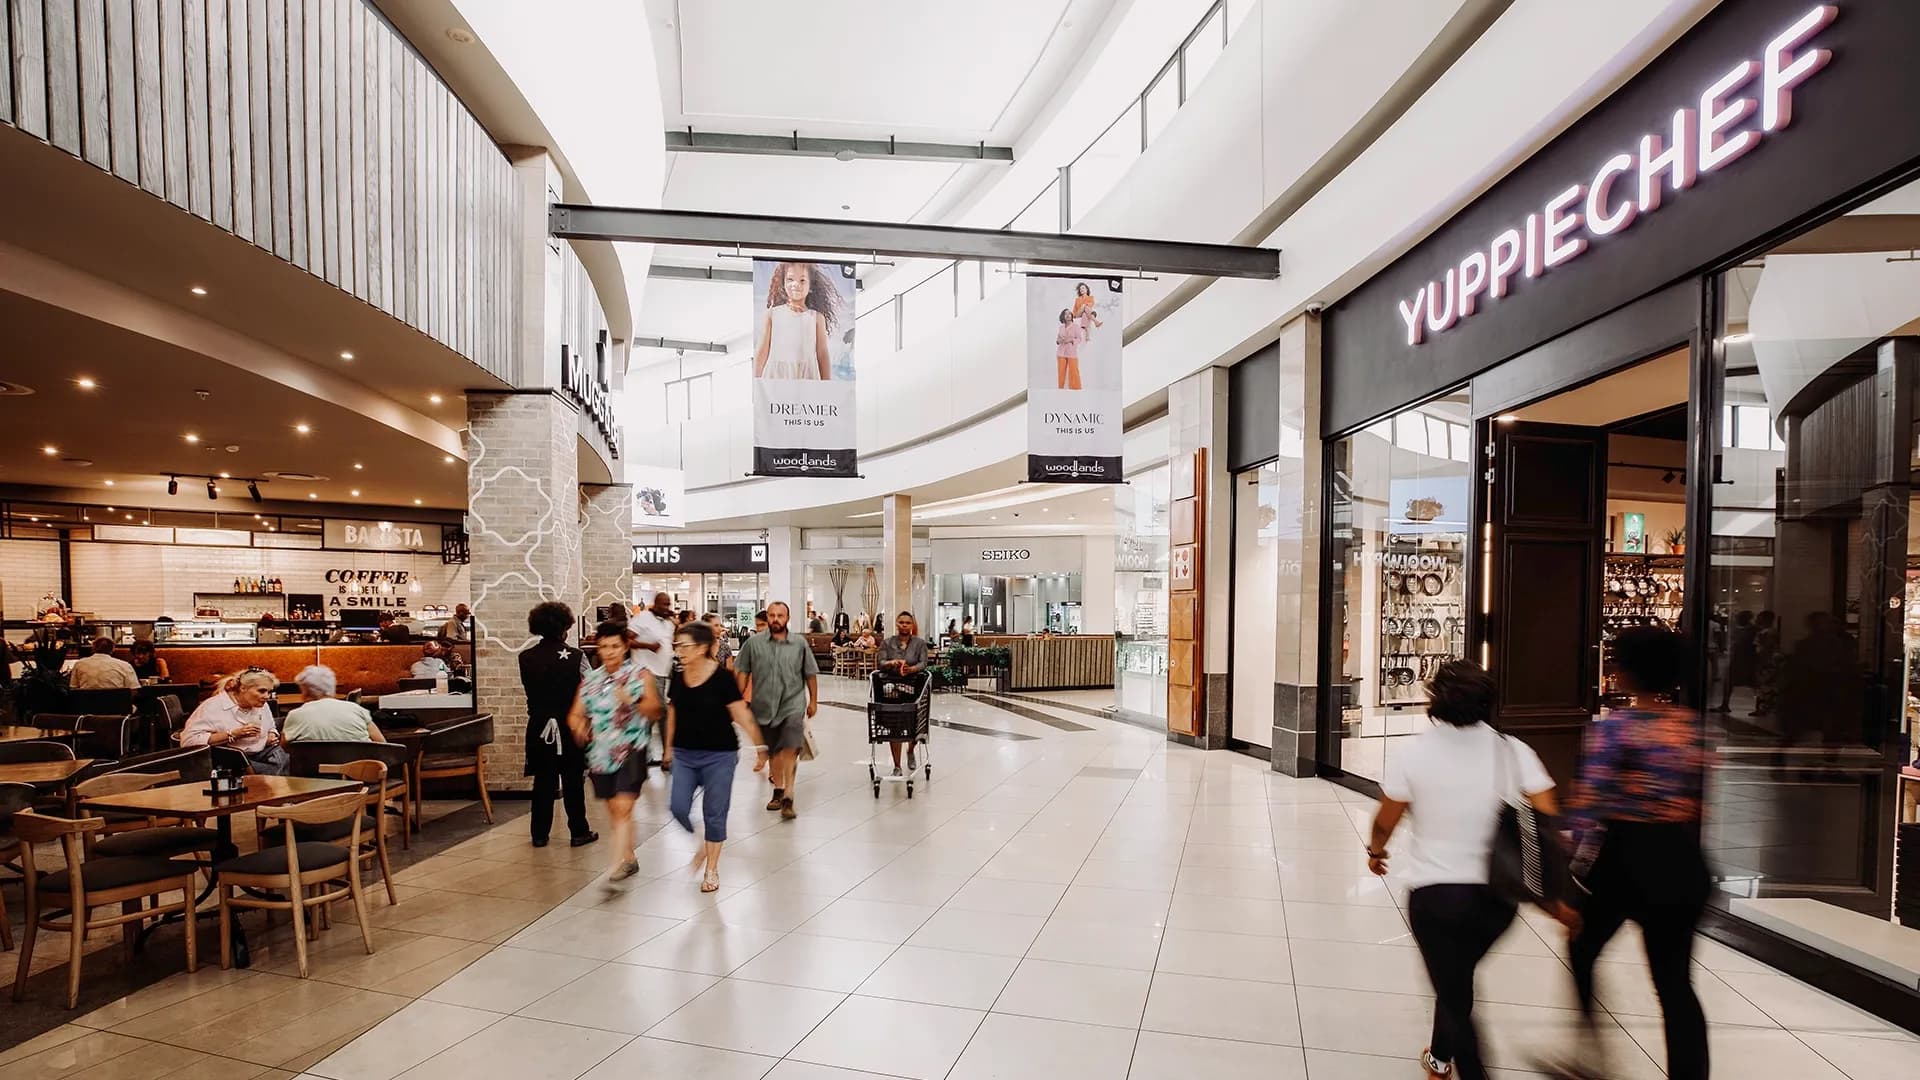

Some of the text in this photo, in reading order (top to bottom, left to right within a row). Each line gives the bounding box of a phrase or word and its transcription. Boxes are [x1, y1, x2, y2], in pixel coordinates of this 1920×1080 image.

[1398, 5, 1838, 346] YUPPIECHEF
[770, 403, 838, 416] DREAMER
[1044, 413, 1104, 424] DYNAMIC
[773, 453, 837, 466] woodlands
[1045, 460, 1105, 473] woodlands
[344, 525, 424, 546] BARSTA
[982, 549, 1030, 560] SEIKO
[325, 569, 409, 584] COFFEE
[339, 585, 346, 594] IS
[329, 597, 407, 607] A SMILE
